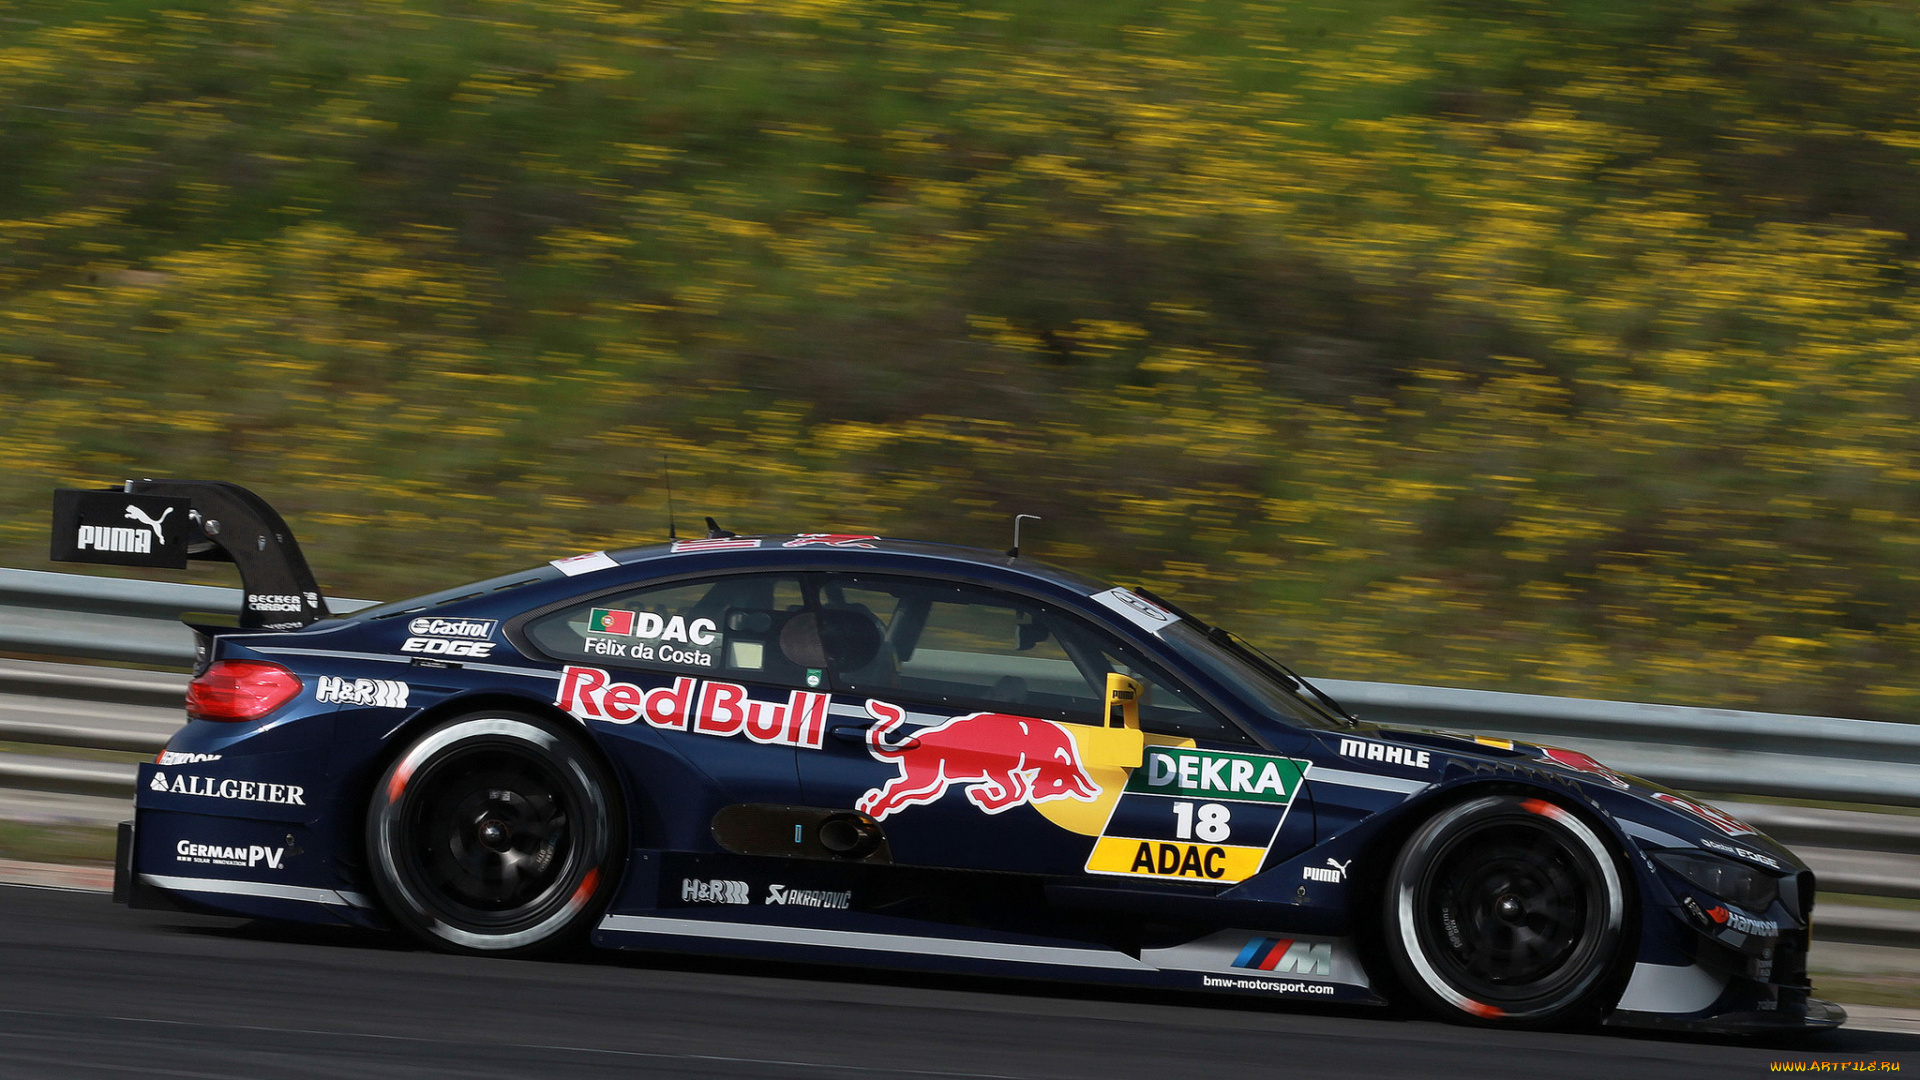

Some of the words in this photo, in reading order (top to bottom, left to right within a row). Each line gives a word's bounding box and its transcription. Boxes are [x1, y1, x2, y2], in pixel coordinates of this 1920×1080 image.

[78, 525, 151, 553] PUMA
[249, 594, 300, 605] BECKER
[249, 603, 301, 612] CARBON
[429, 619, 491, 637] Castrol
[636, 612, 717, 645] DAC
[401, 637, 497, 658] EDGE
[584, 637, 626, 657] Félix
[630, 642, 655, 660] da
[658, 644, 712, 667] Costa
[555, 667, 697, 731] Red
[693, 681, 831, 749] Bull
[1340, 739, 1431, 769] MAHLE
[1148, 753, 1287, 796] DEKRA
[169, 774, 306, 806] ALLGEIER
[1172, 802, 1231, 842] 18
[1131, 843, 1225, 879] ADAC
[1303, 866, 1340, 883] PUMA
[1203, 976, 1334, 995] bmw-motorsport.com
